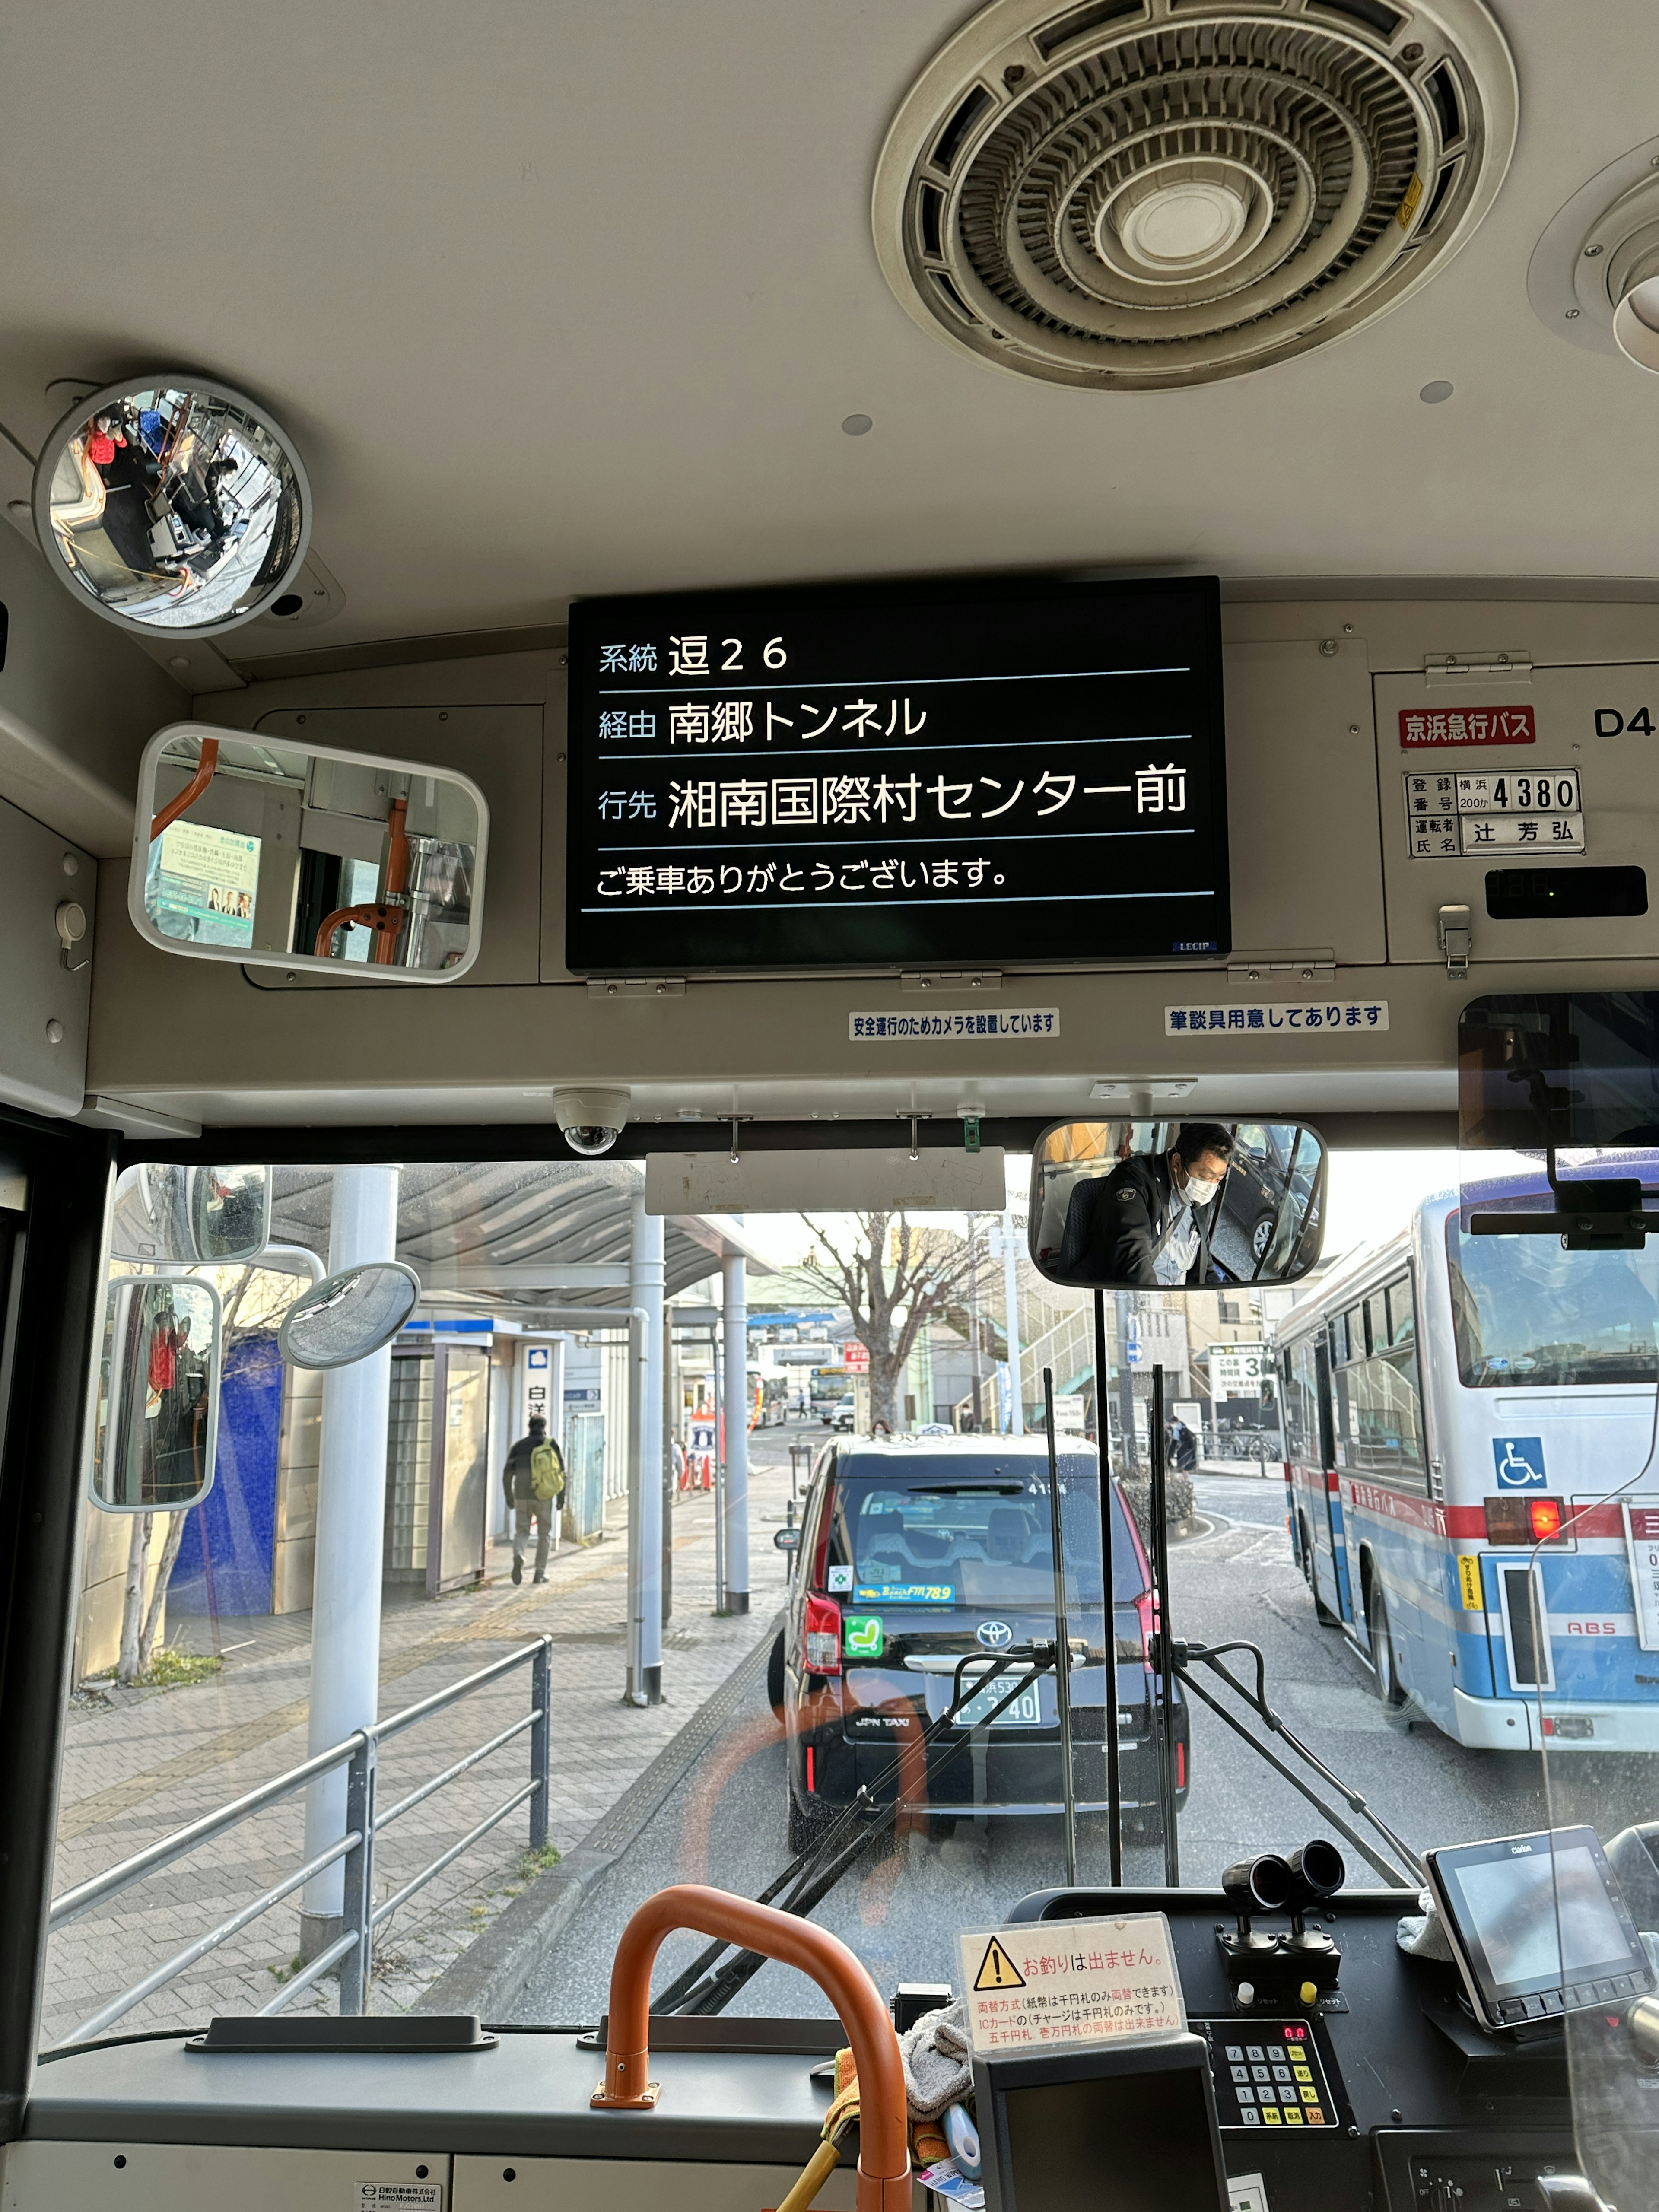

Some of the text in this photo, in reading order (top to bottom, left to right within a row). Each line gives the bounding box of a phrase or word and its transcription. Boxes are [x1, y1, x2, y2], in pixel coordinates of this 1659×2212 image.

[599, 644, 657, 673] 系統
[599, 698, 927, 744] 経由 南郷トンネル
[1405, 712, 1530, 741] 京浜急行バス
[1595, 707, 1659, 737] D4
[1412, 778, 1451, 792] 登録
[1460, 779, 1487, 790] 横浜
[598, 763, 1186, 829] 行先 湘南国際村センター前
[1494, 778, 1573, 808] 4380
[1414, 797, 1452, 811] 番号
[1461, 798, 1488, 808] 200か
[1416, 819, 1453, 833] 運転者
[1417, 839, 1455, 852] 氏名
[597, 857, 1007, 896] ご乗車ありがとうございます。
[1180, 942, 1209, 950] LECIP
[854, 1013, 1055, 1036] 安全運行のためカメラを設置しています
[1170, 1005, 1382, 1031] 筆談具用意してあります
[1029, 1483, 1067, 1494] 414
[1568, 1623, 1615, 1634] ABS
[856, 1718, 909, 1727] JPN TAXI
[1023, 1948, 1162, 1977] お釣りは出ません。
[977, 1985, 1174, 2014] 両替方式(紙幣は千円札のみ両替できます)
[979, 2002, 1165, 2030] ICカードの(チャージは千円札のみです。)
[1252, 2049, 1259, 2057] 8
[1273, 2049, 1279, 2057] 9
[1237, 2069, 1243, 2078] 4
[1259, 2069, 1264, 2078] 5
[1279, 2069, 1285, 2078] 6
[1263, 2090, 1270, 2098] 2
[1286, 2090, 1291, 2098] 3
[1247, 2112, 1253, 2120] 0
[1309, 2112, 1322, 2120] 入力
